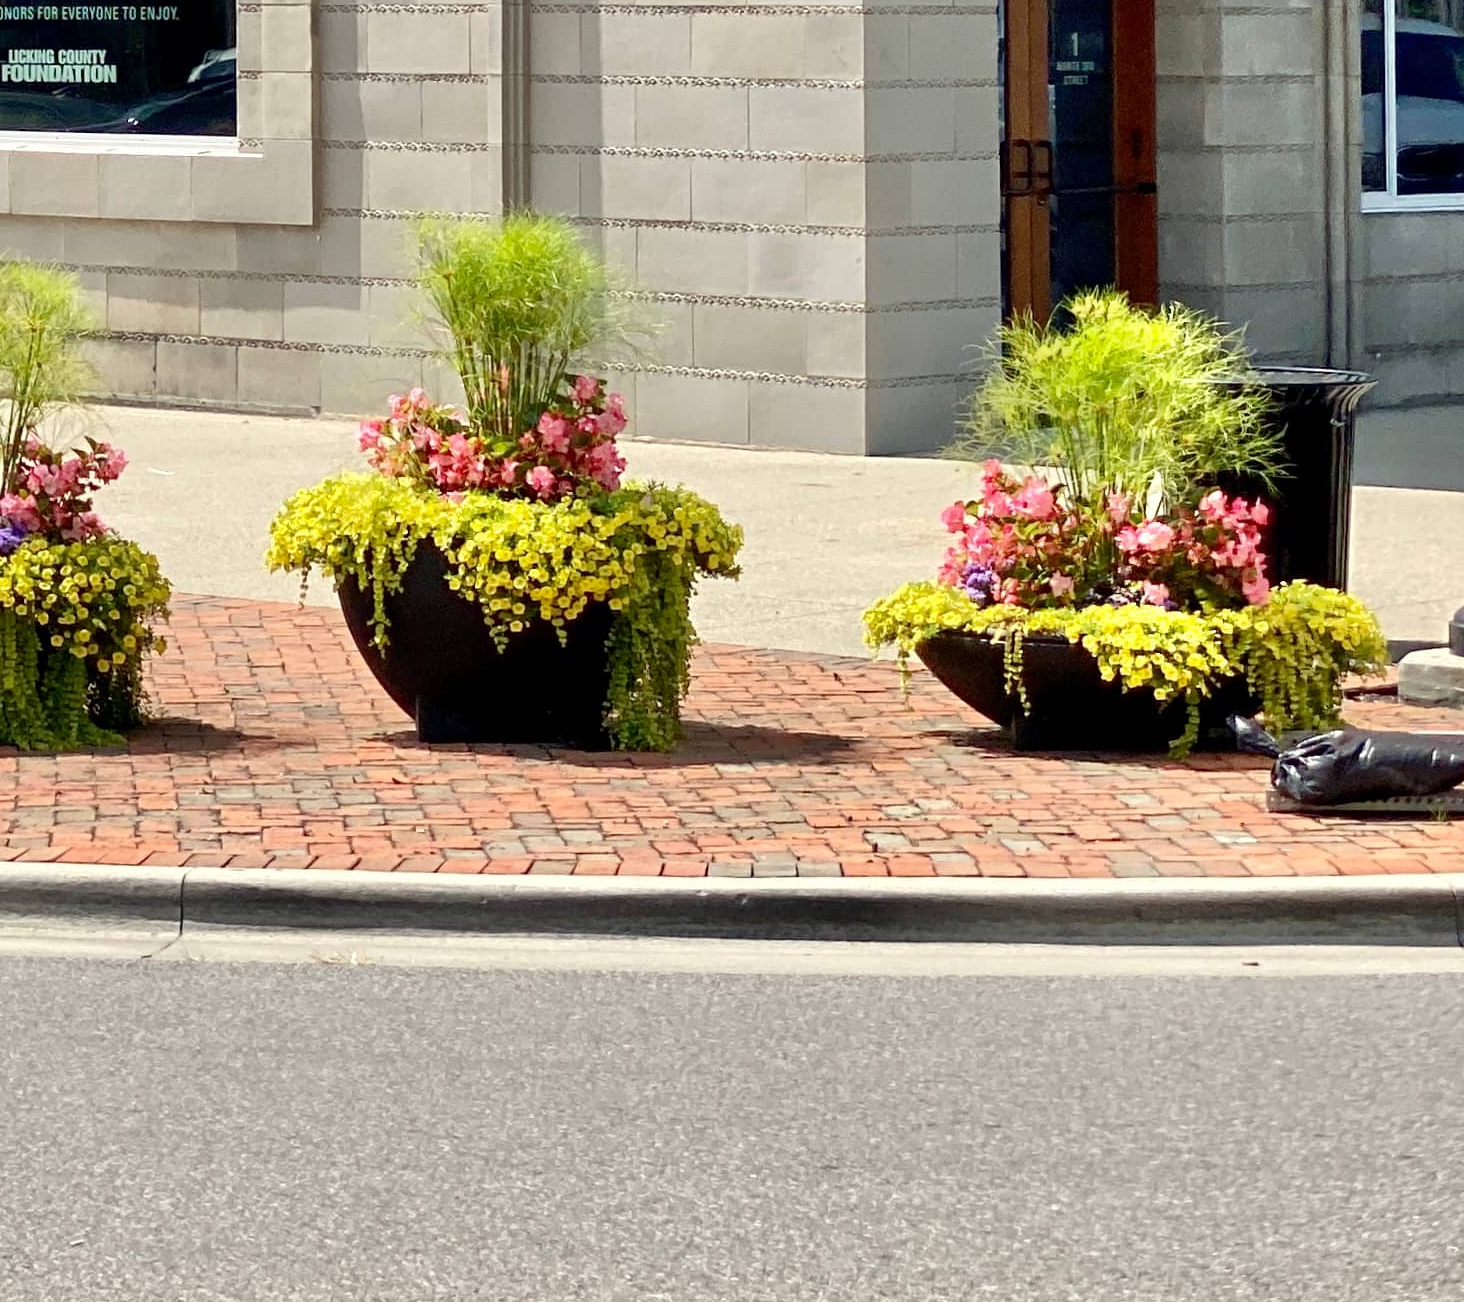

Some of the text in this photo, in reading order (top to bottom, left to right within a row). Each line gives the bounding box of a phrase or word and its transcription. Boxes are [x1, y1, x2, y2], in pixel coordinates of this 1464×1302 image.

[37, 6, 59, 20] FOR
[61, 6, 120, 20] EVERYONE
[123, 6, 137, 20] TO
[139, 6, 180, 21] ENJOY.
[1071, 32, 1078, 56] 1
[8, 49, 107, 64] LICKING COUNTY
[1, 64, 118, 84] FOUNDATION
